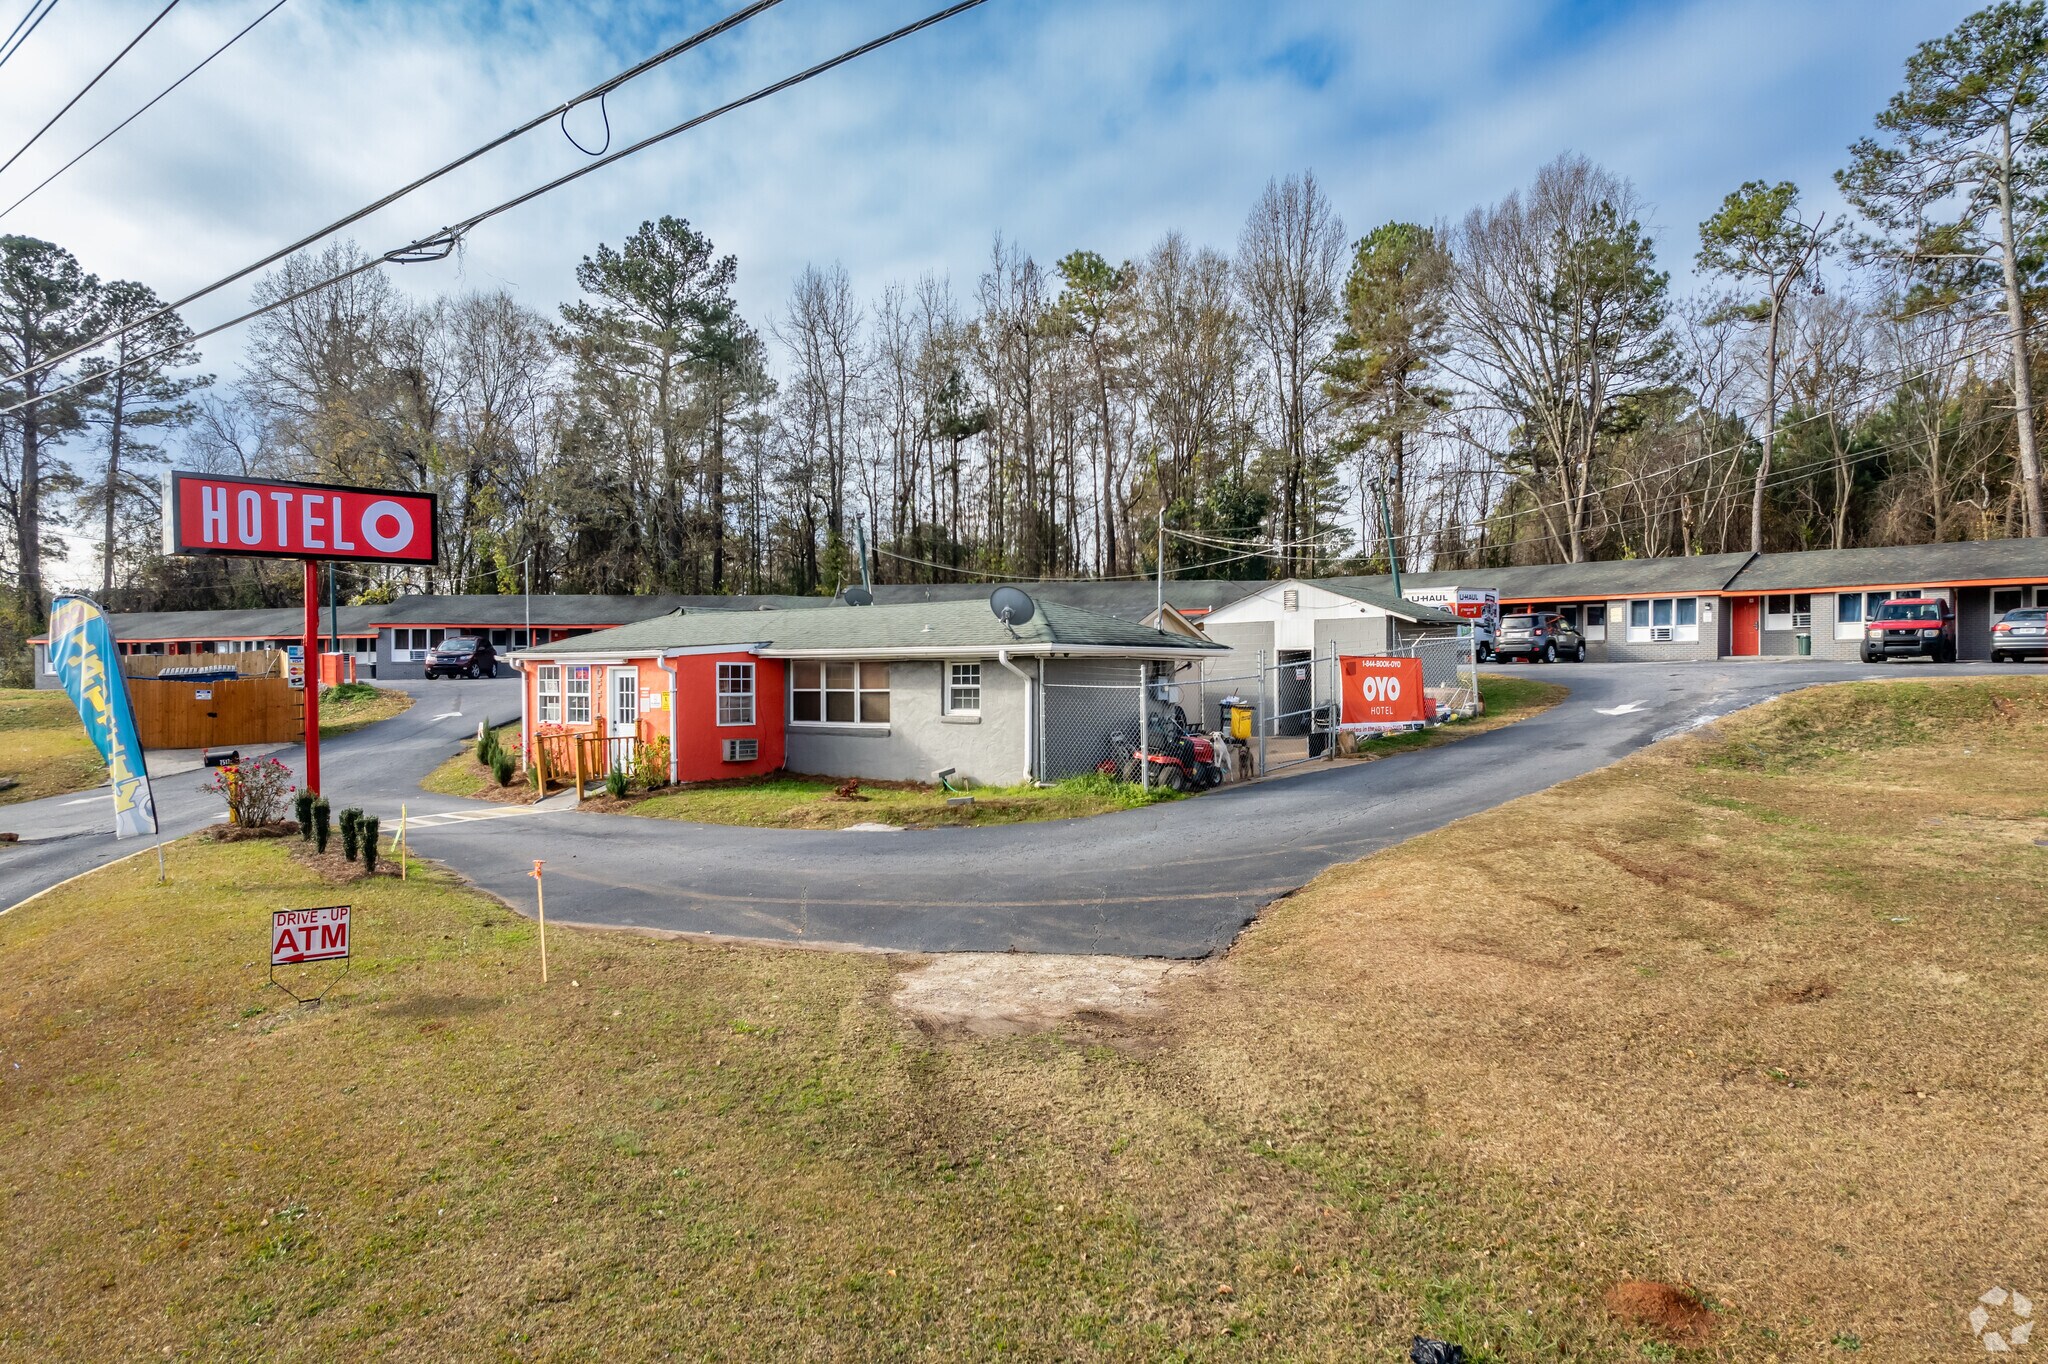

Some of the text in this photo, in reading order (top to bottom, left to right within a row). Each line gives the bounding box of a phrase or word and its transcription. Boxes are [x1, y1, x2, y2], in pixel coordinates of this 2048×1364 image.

[202, 486, 355, 550] HOTEL
[1411, 594, 1449, 602] U-HAUL
[1459, 593, 1479, 601] U-HAUL
[1362, 676, 1401, 701] OYO
[1370, 706, 1394, 715] HOTEL
[274, 924, 346, 954] ATM
